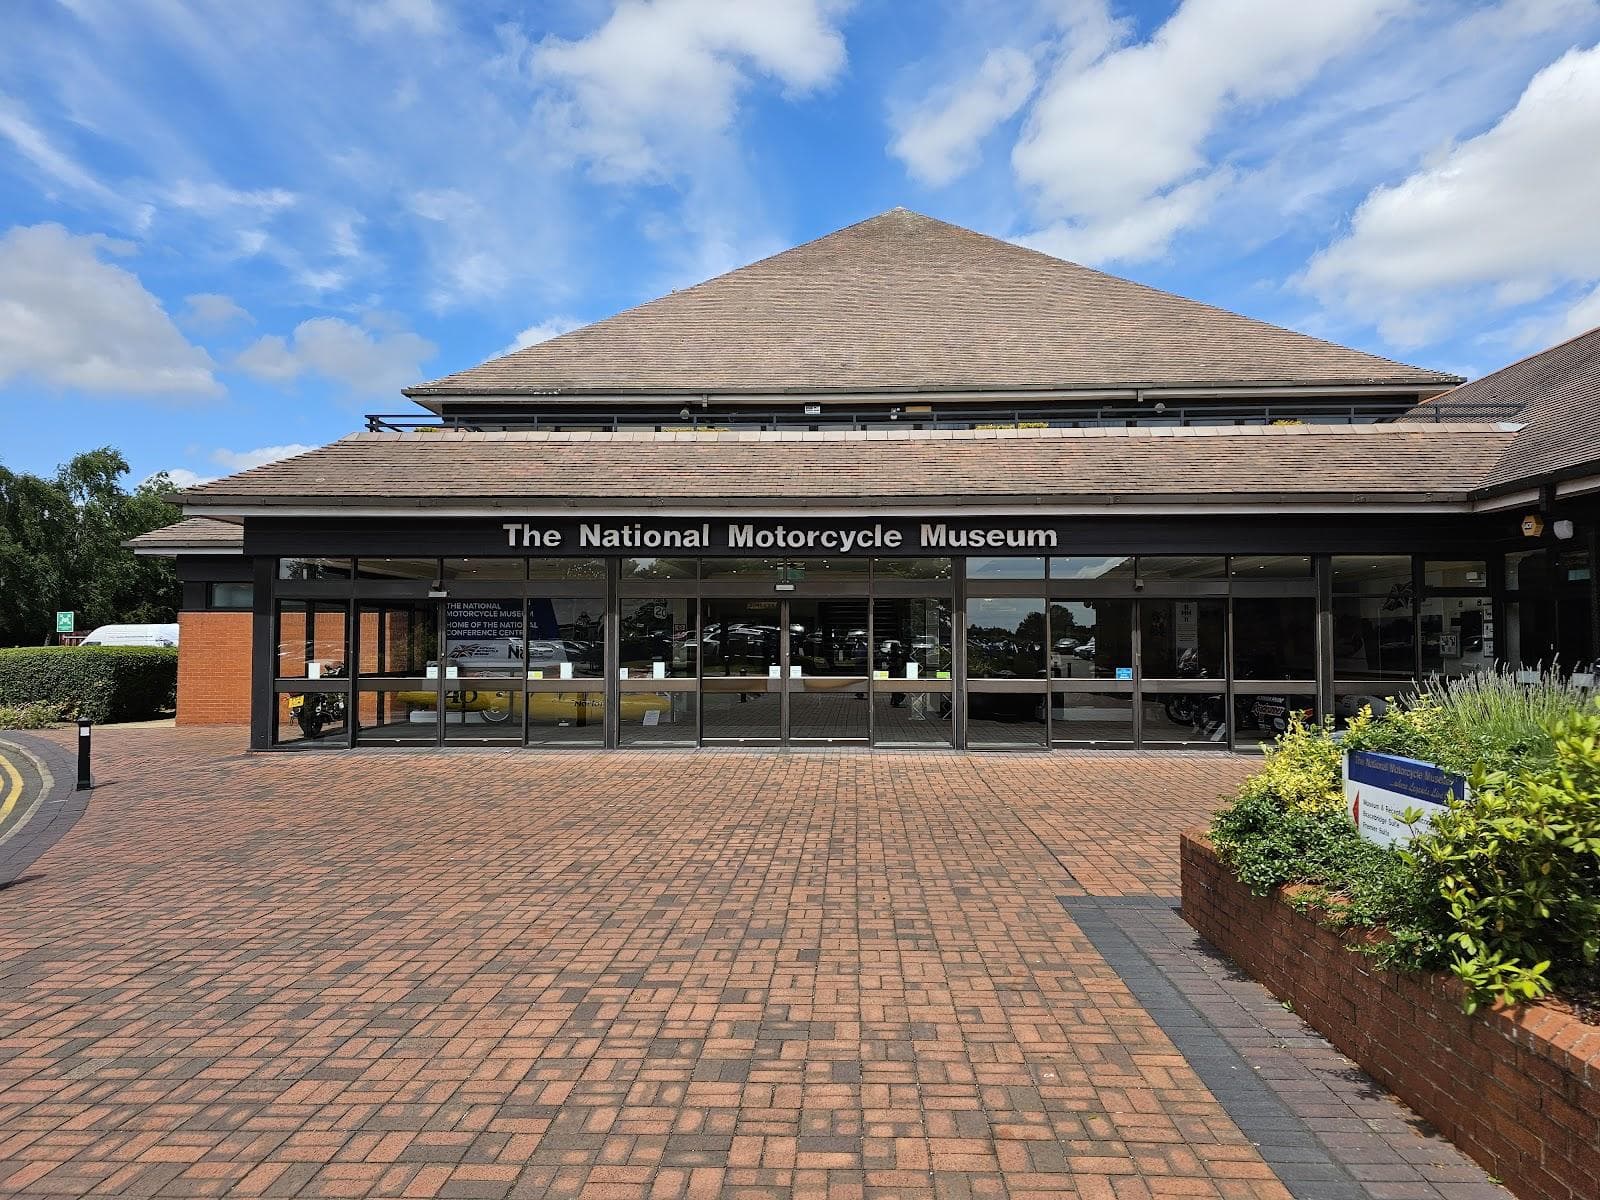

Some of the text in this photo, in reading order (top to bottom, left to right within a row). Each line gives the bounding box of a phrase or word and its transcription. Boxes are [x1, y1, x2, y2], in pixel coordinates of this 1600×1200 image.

[502, 524, 1058, 552] The National Motorcycle Museum
[447, 610, 498, 618] MOTORCYCLE
[470, 621, 482, 629] OF
[483, 621, 499, 629] THE
[499, 621, 539, 629] NATIOAL
[447, 629, 497, 637] CONFERENCE
